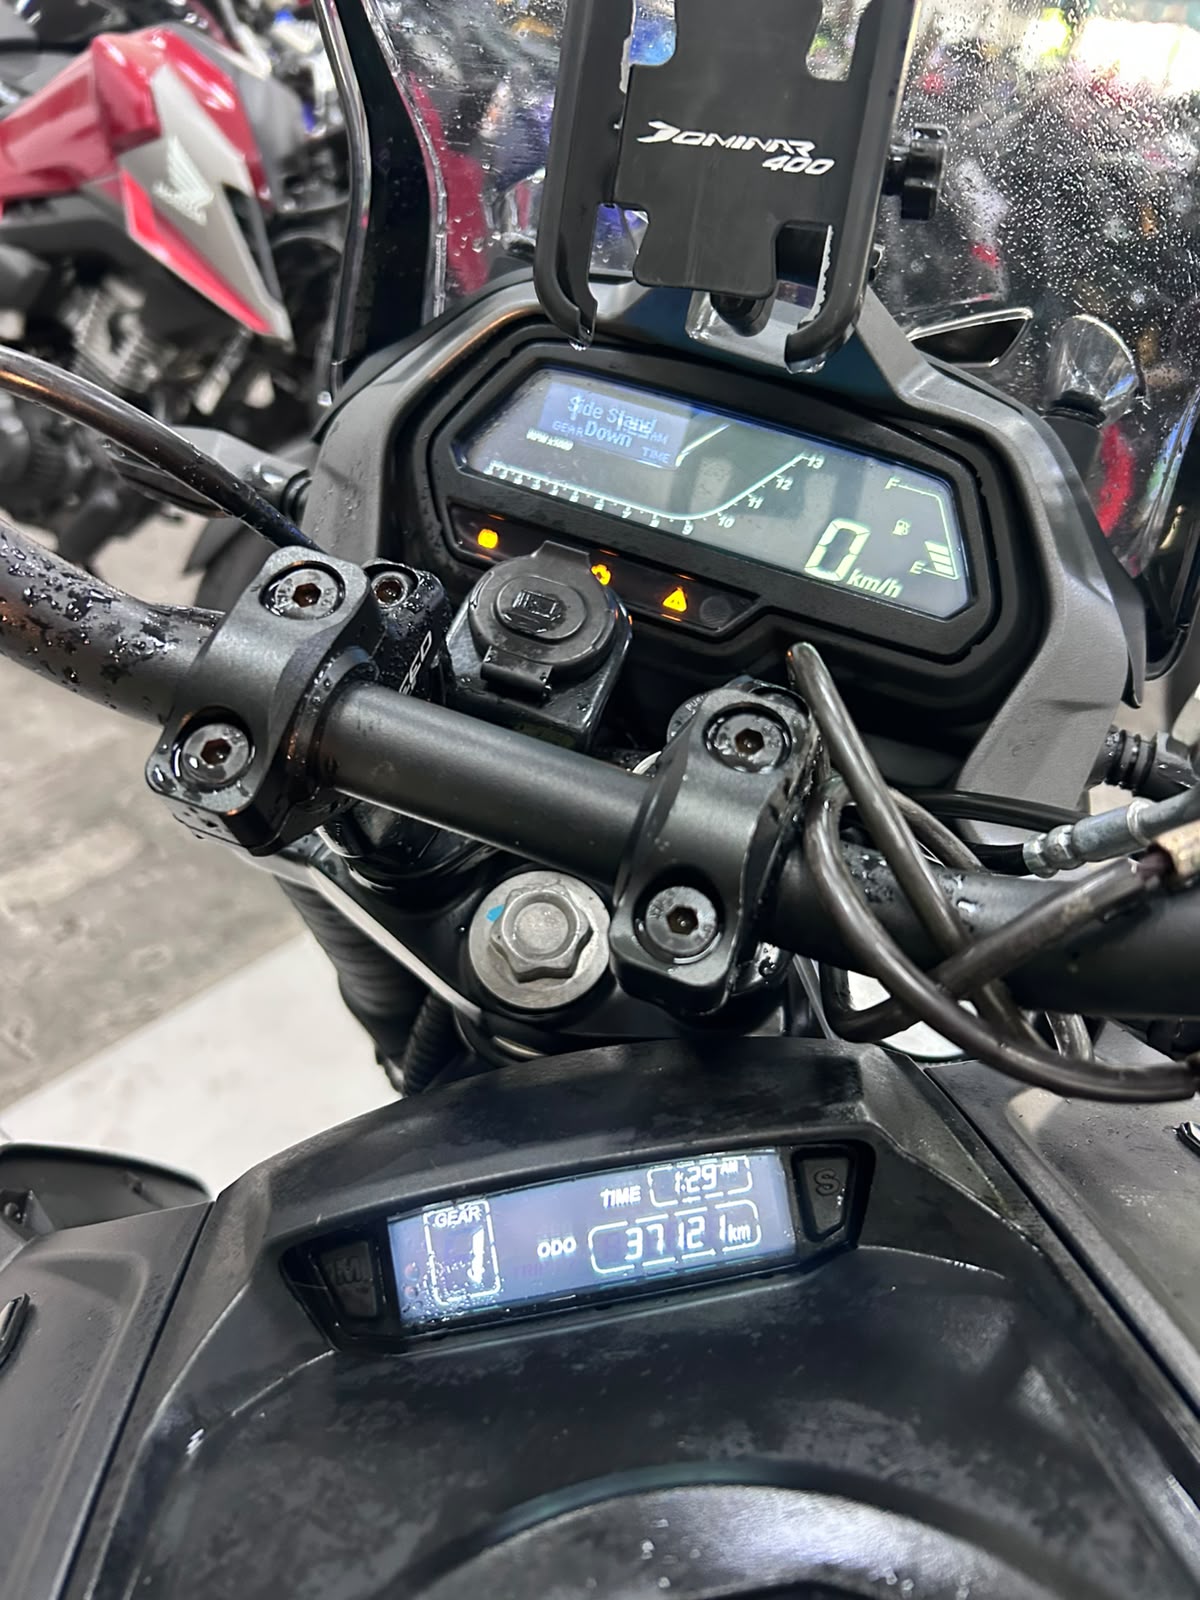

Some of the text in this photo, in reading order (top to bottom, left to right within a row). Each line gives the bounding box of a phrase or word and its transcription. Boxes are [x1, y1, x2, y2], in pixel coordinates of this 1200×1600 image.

[636, 120, 815, 157] DOMINAR
[762, 155, 835, 175] 400
[568, 395, 657, 434] Side Stand
[585, 420, 632, 447] Down
[807, 455, 825, 469] 13
[775, 476, 794, 491] 12
[884, 475, 900, 489] F
[748, 496, 764, 509] 11
[682, 522, 694, 536] 9
[718, 515, 735, 528] 10
[804, 518, 903, 598] 0 km/h
[909, 560, 926, 575] E
[600, 1159, 739, 1208] TIME 1:29 AM
[813, 1168, 841, 1196] S
[434, 1206, 481, 1228] GEAR
[537, 1236, 577, 1258] ODO
[624, 1214, 727, 1260] 37121
